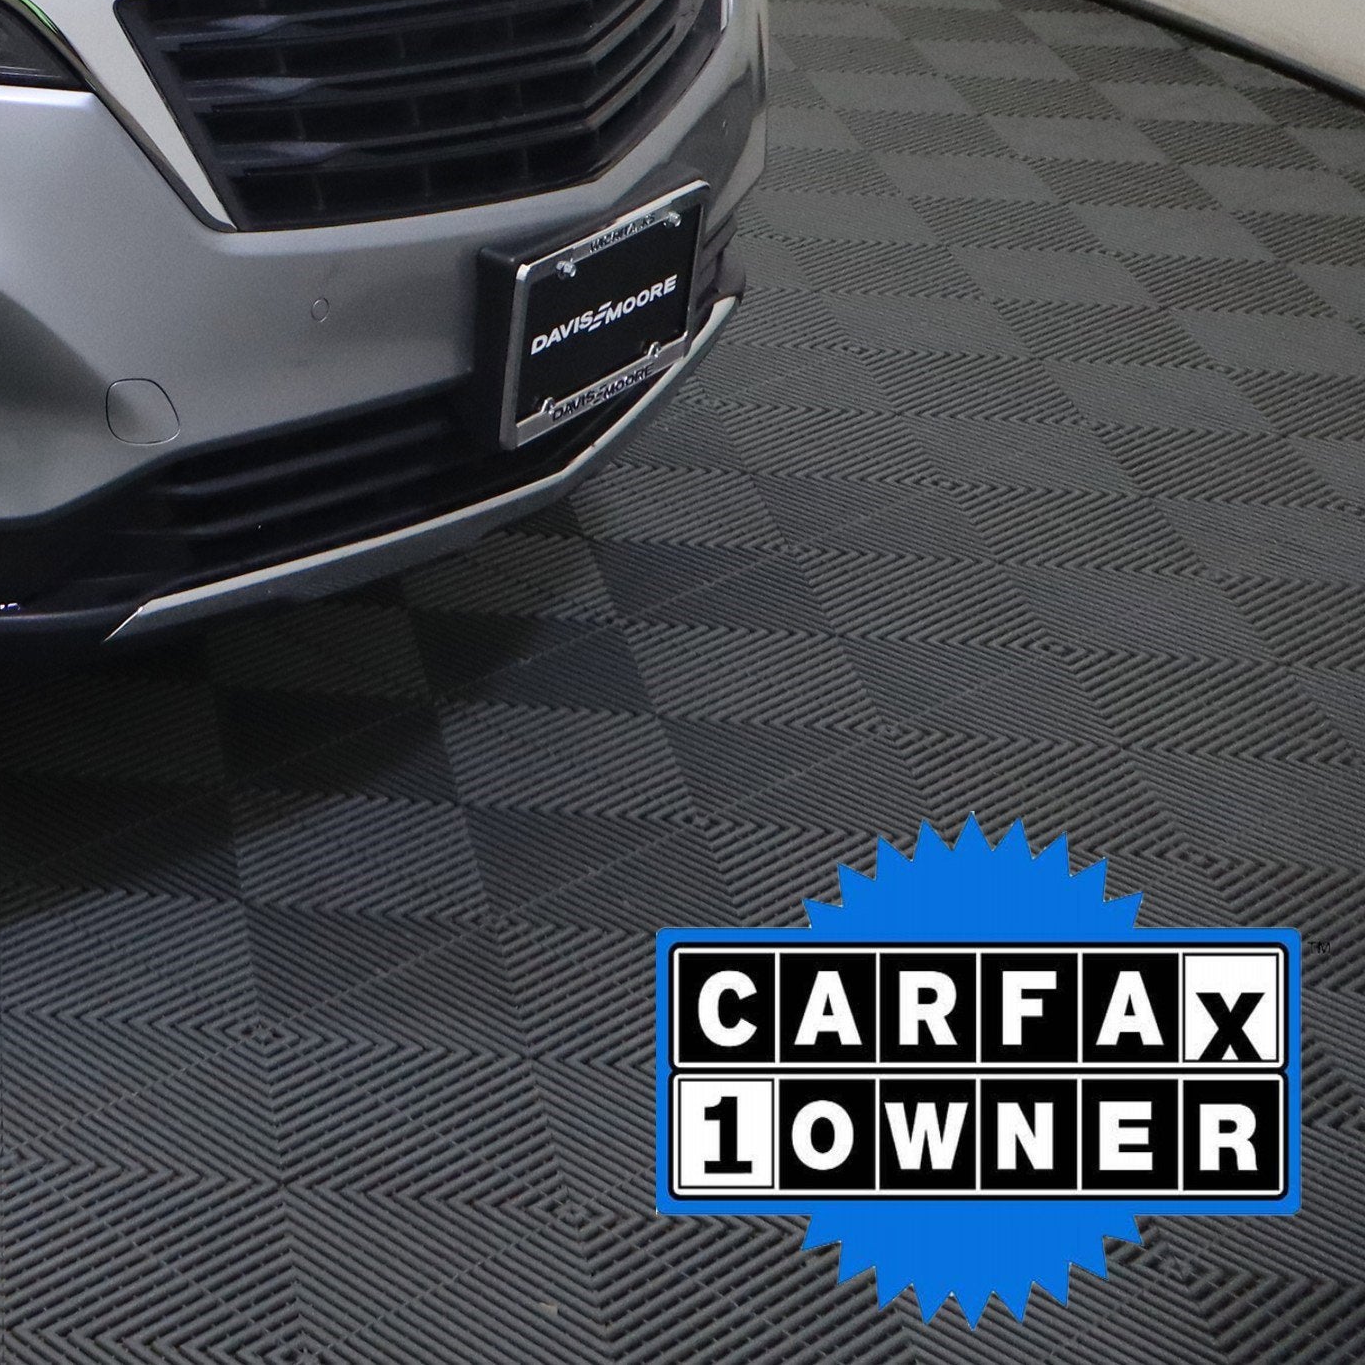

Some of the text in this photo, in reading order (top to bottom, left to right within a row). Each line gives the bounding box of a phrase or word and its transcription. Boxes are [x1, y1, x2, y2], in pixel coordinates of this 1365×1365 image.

[530, 274, 678, 356] DAVIS MOORE
[552, 363, 655, 423] DAVIS MOORE
